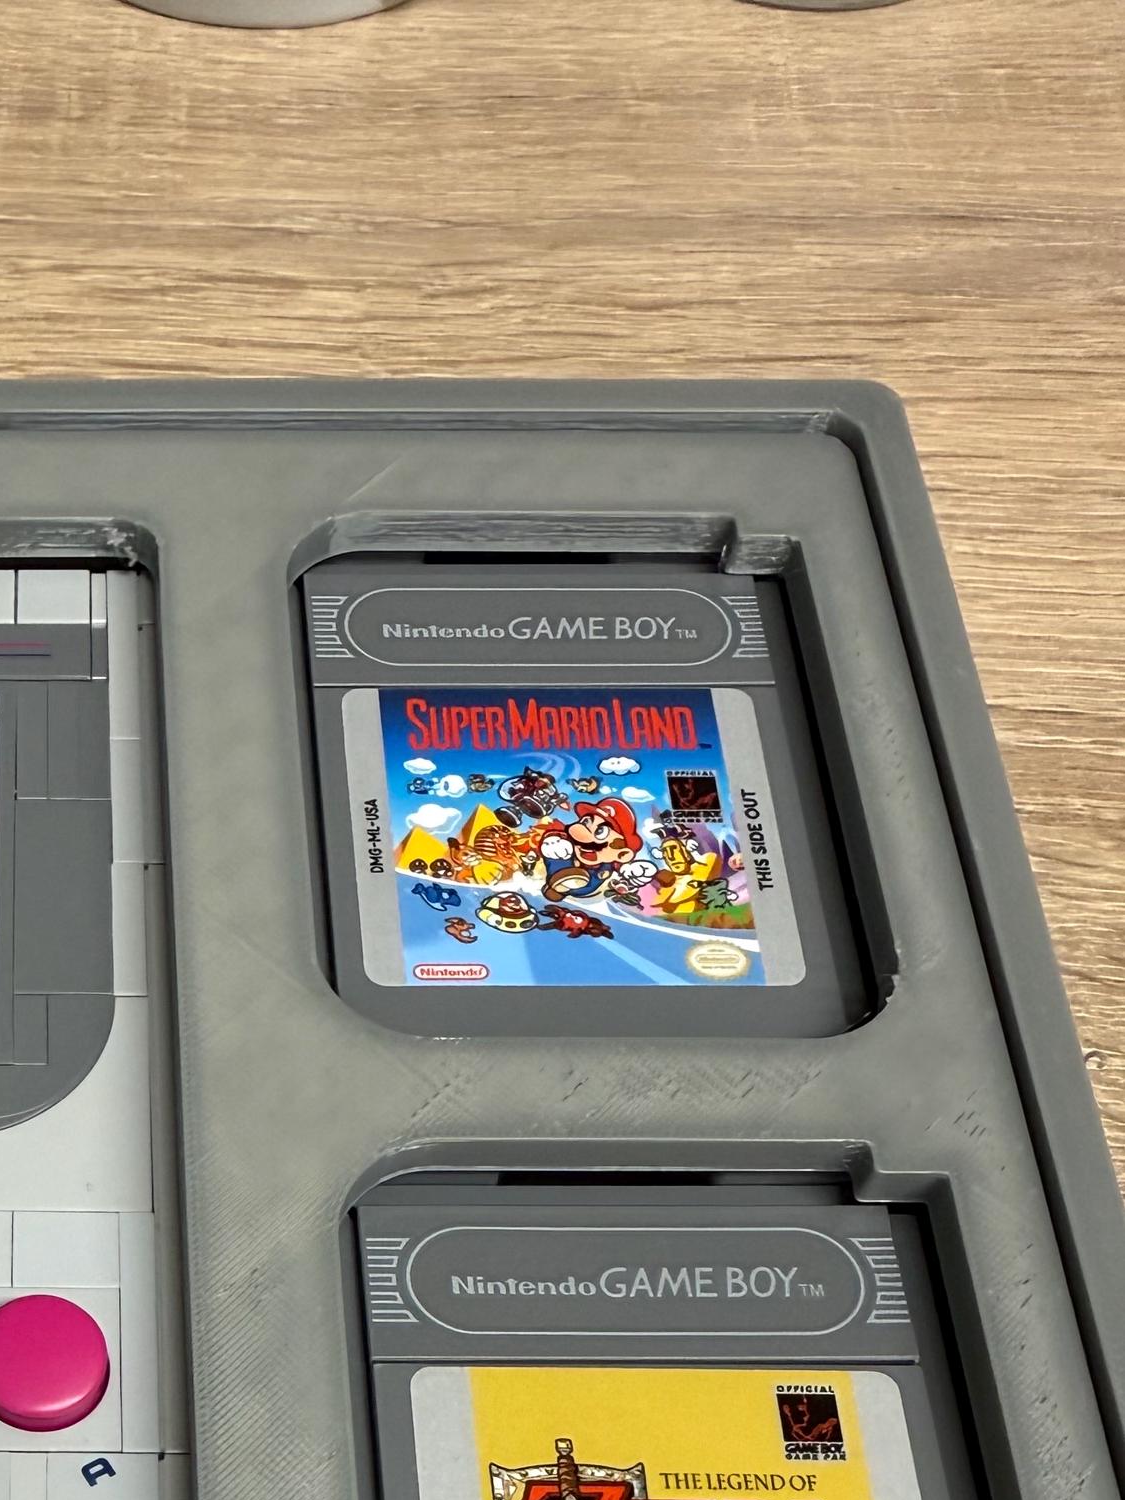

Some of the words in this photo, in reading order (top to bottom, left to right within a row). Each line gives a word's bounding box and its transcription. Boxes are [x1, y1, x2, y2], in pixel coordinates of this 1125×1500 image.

[382, 622, 505, 640] Nintendo
[508, 616, 608, 641] GAME
[615, 616, 676, 641] BOY
[405, 698, 508, 750] SUPER
[504, 698, 610, 750] MARIO
[612, 698, 698, 750] LAND
[740, 788, 761, 820] OUT
[364, 798, 385, 874] DMG-ML-USA
[747, 823, 768, 855] SIDE
[754, 858, 774, 892] THIS
[451, 1275, 597, 1297] Nintendo
[599, 1266, 719, 1299] GAME
[726, 1266, 798, 1299] BOY
[81, 1457, 116, 1487] A
[659, 1472, 703, 1490] THE
[707, 1472, 786, 1491] LEGEND
[789, 1474, 818, 1492] OF
